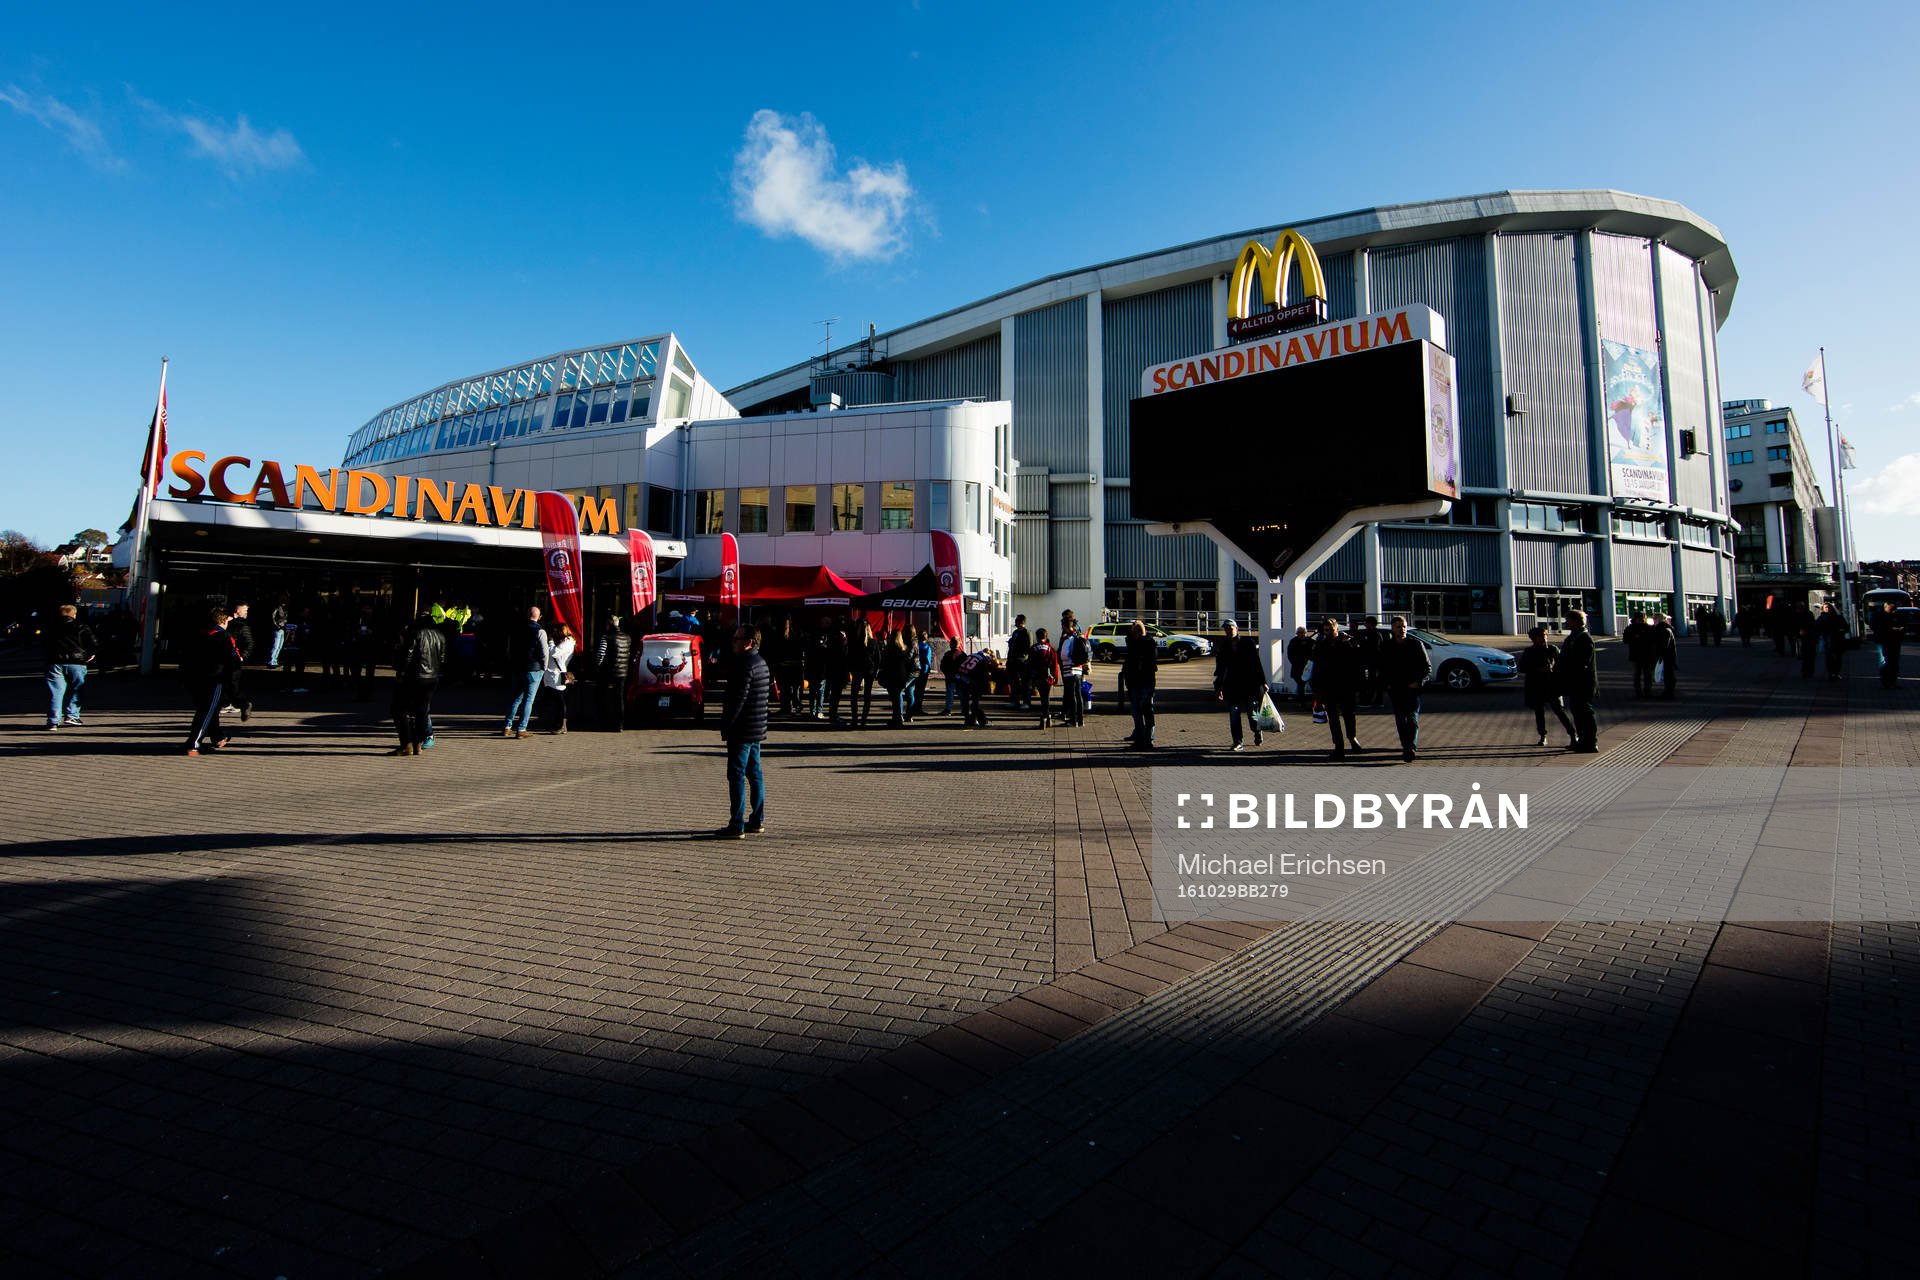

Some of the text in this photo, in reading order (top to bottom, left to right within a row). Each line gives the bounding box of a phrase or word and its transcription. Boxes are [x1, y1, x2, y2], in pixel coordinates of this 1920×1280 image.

[1153, 311, 1413, 394] SCANDINAVIUM
[1242, 304, 1311, 330] ALLTID ÖPPET
[168, 450, 619, 535] SCANDINAVIM
